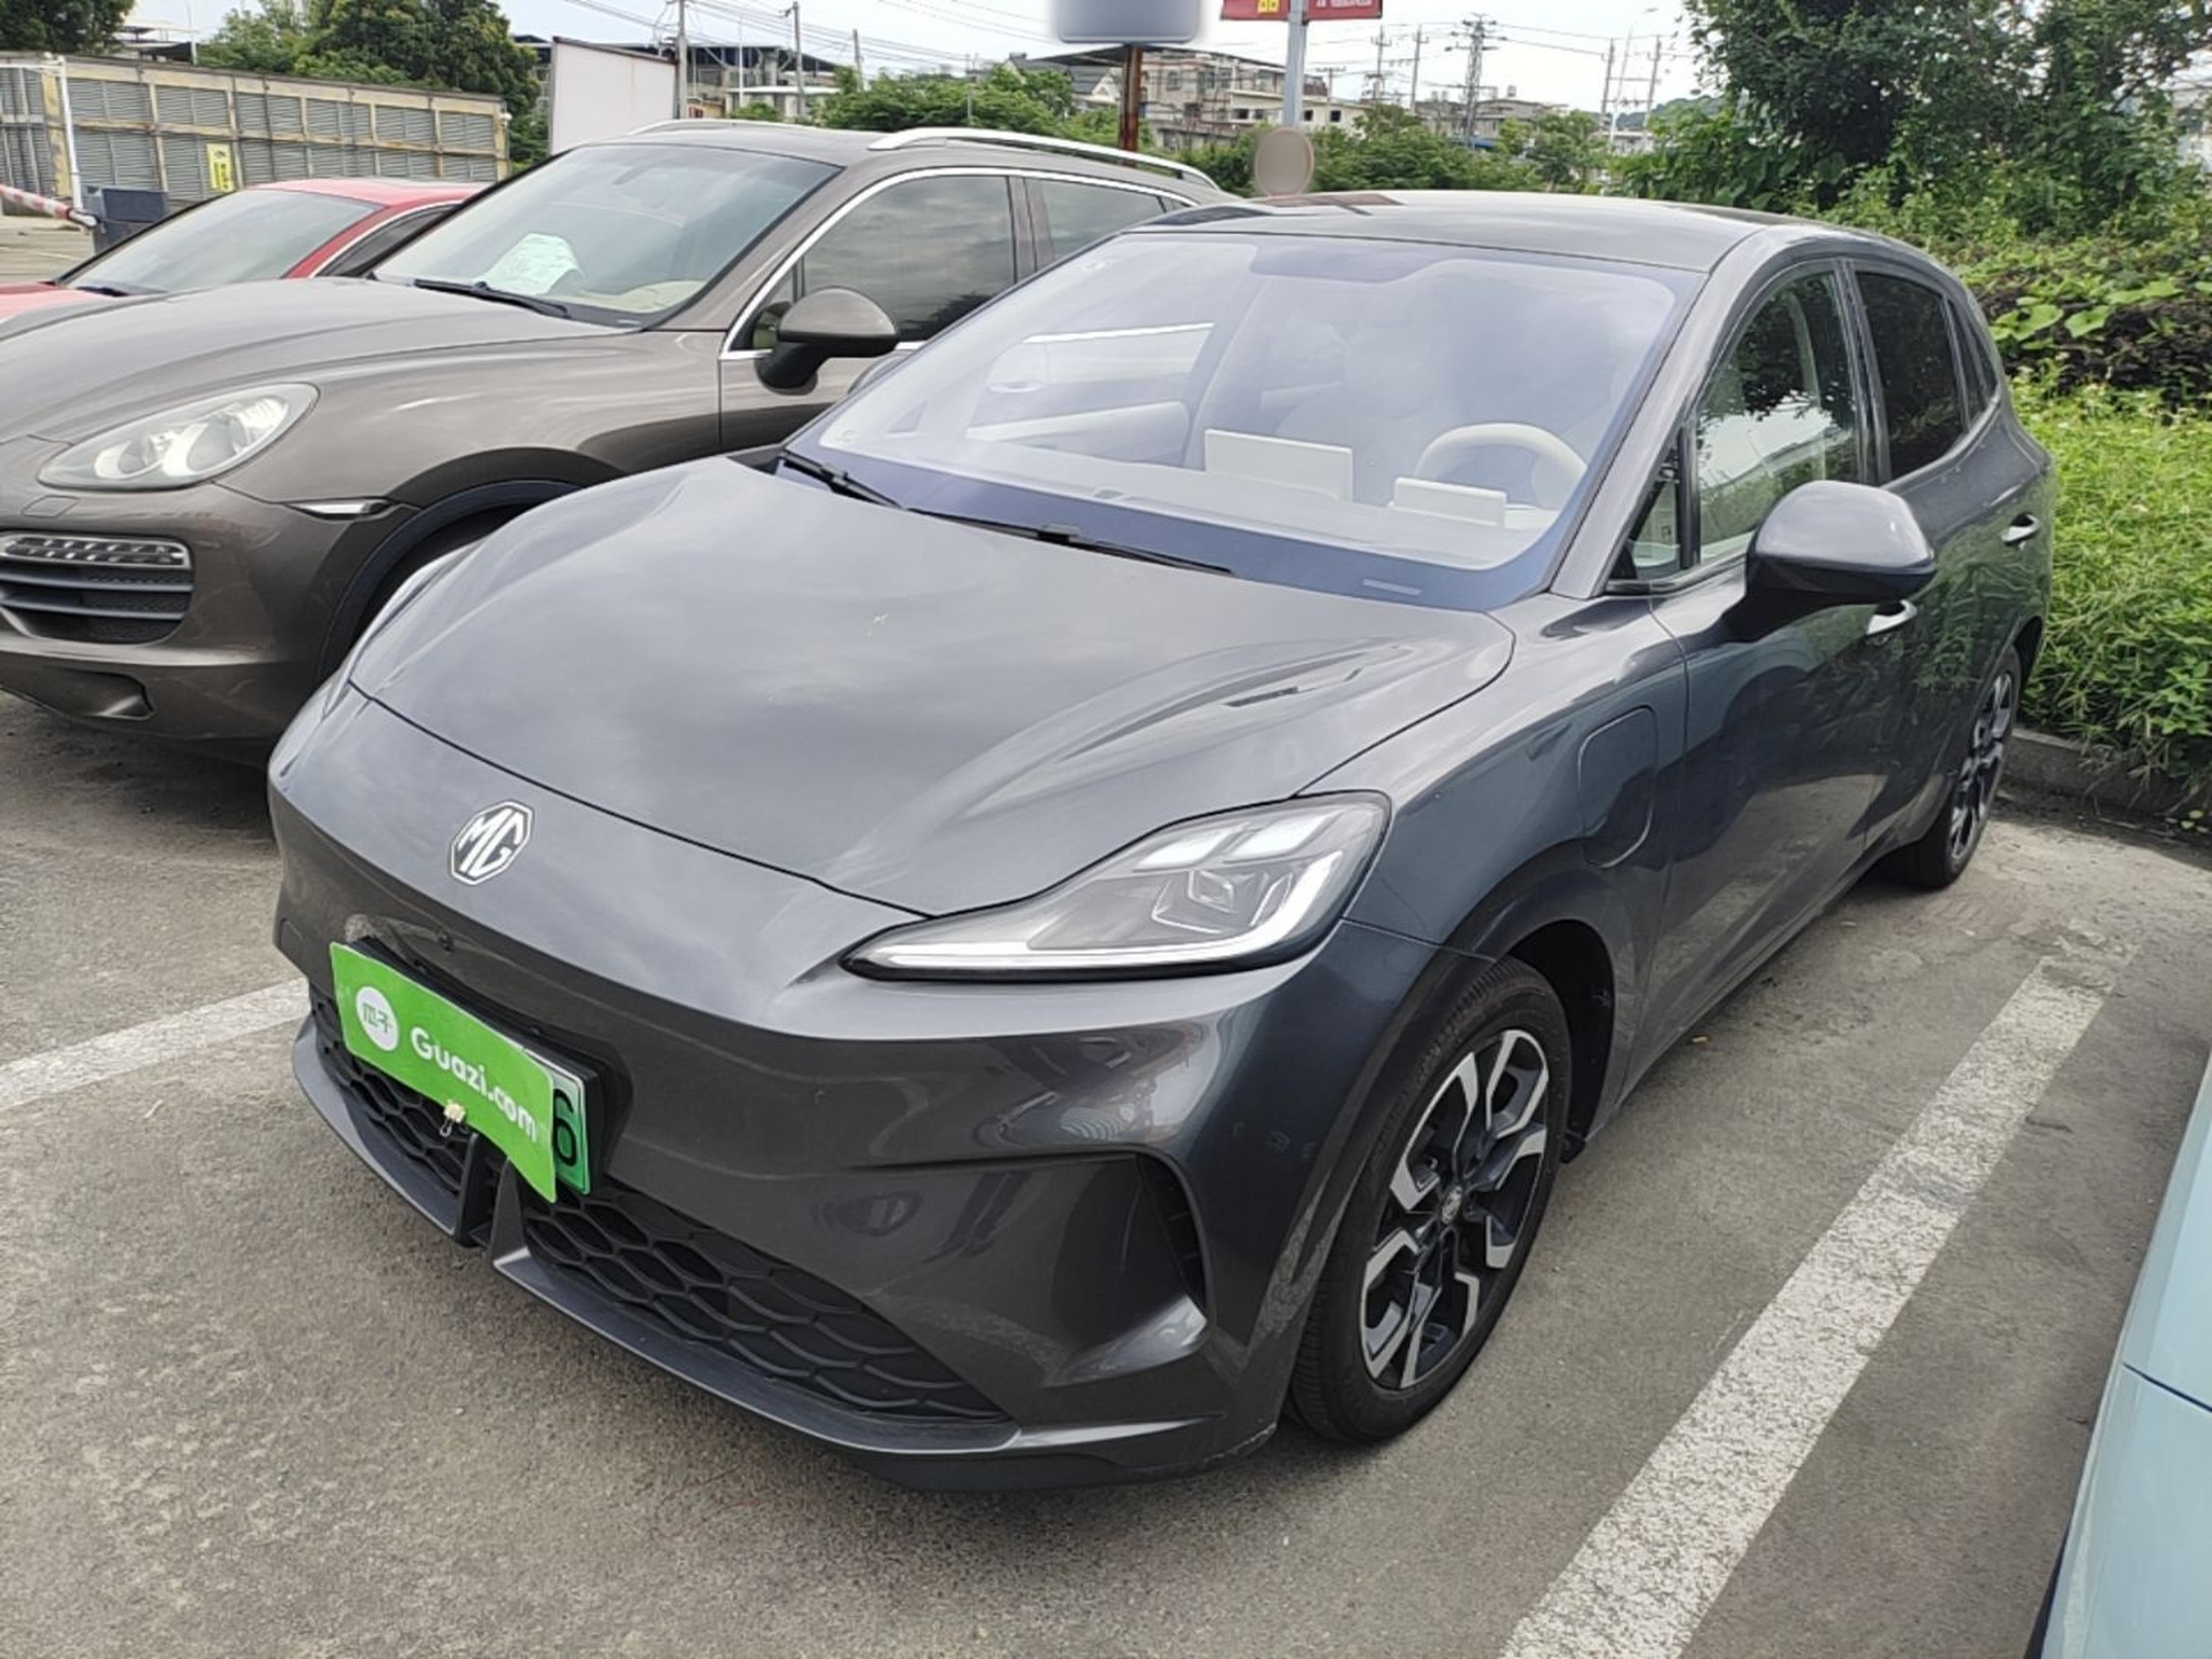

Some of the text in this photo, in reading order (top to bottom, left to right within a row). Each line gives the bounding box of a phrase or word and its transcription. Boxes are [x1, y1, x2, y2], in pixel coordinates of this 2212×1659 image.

[458, 808, 524, 877] MG
[410, 1027, 537, 1142] Guazi.com
[552, 1088, 577, 1166] 6
